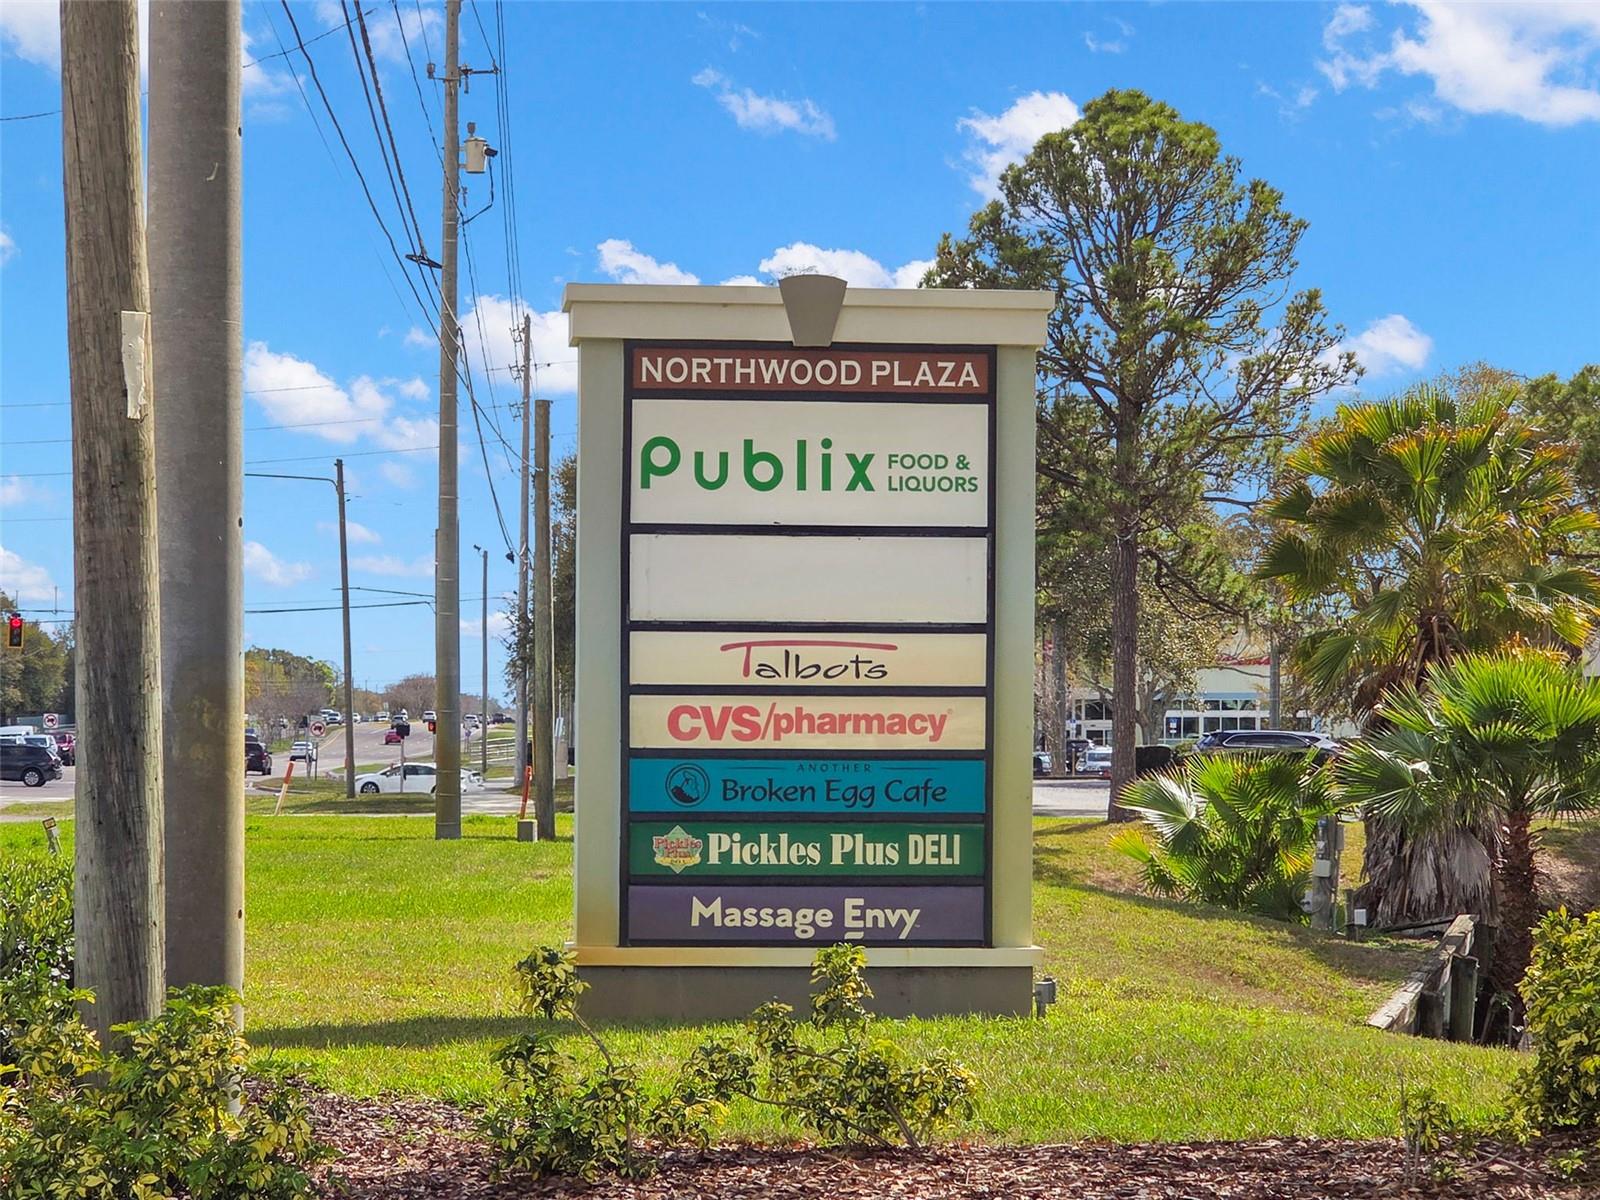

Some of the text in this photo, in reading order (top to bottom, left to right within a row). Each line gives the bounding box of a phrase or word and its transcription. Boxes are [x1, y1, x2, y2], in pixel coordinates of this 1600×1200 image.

[641, 357, 980, 387] NORTHWOOD PLAZA
[640, 436, 875, 492] Publix
[888, 454, 970, 470] FOOD &
[888, 476, 978, 492] LIQUORS
[720, 640, 898, 679] Talbots
[797, 763, 872, 773] ANOTHER
[721, 779, 947, 808] Broken Egg Cafe
[707, 833, 960, 866] Pickles Plus DELI
[691, 896, 920, 939] Massage Envy
